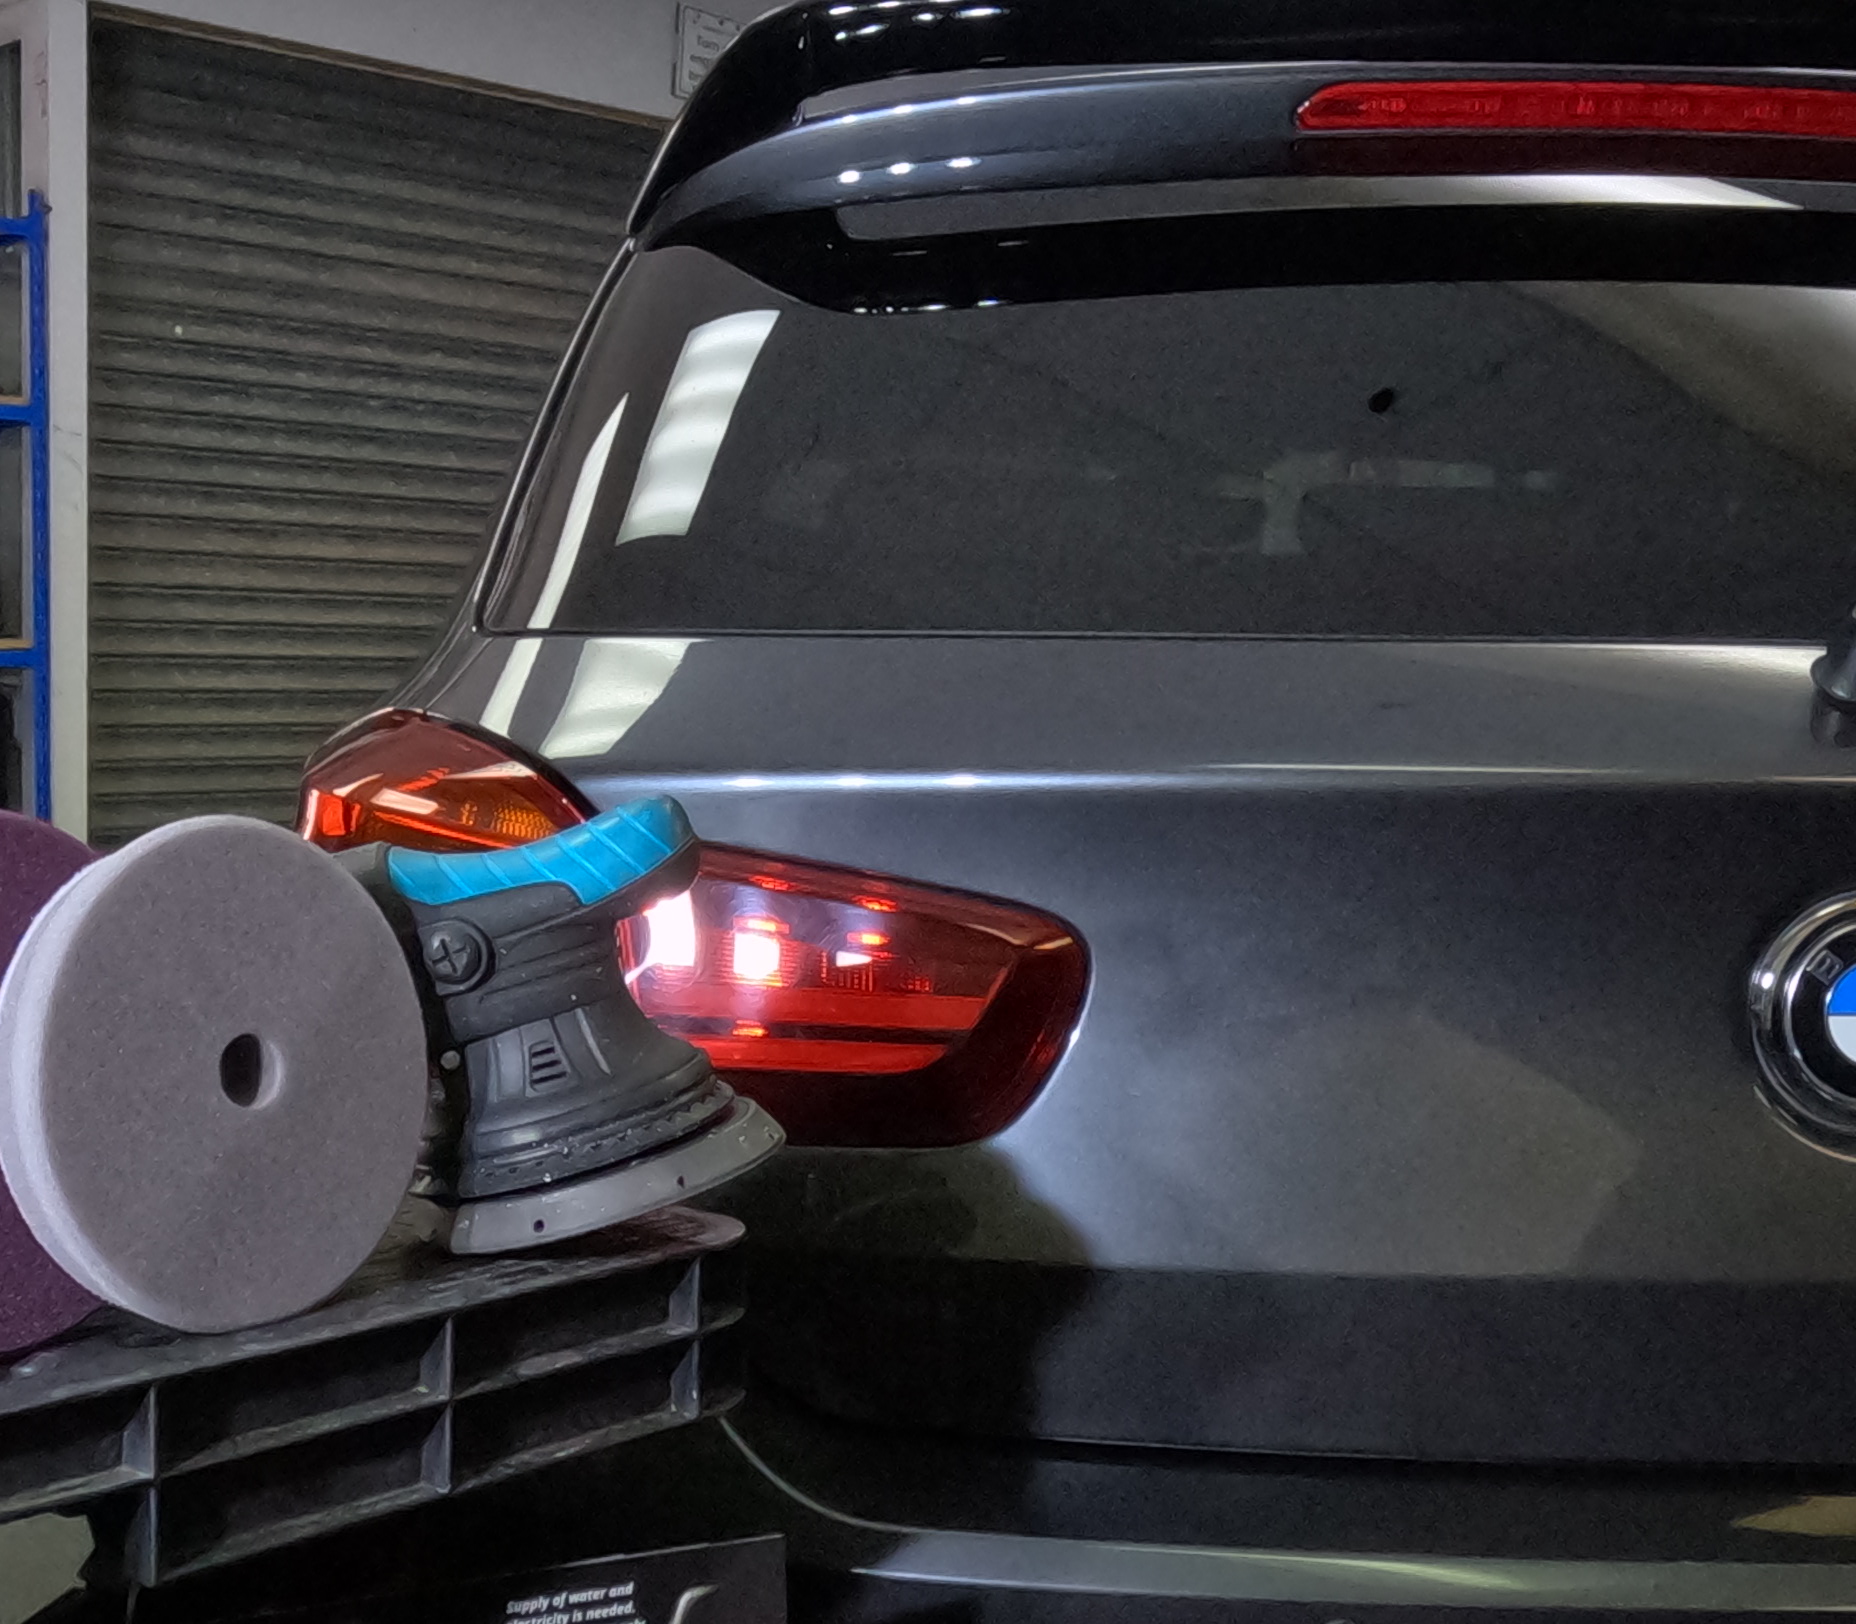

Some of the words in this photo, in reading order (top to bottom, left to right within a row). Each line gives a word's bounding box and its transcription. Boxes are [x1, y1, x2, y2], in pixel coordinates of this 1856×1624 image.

[506, 1594, 550, 1616] Supply
[552, 1592, 567, 1609] of
[569, 1586, 607, 1605] water
[608, 1581, 635, 1599] and
[572, 1606, 584, 1623] is
[585, 1600, 637, 1621] needed.
